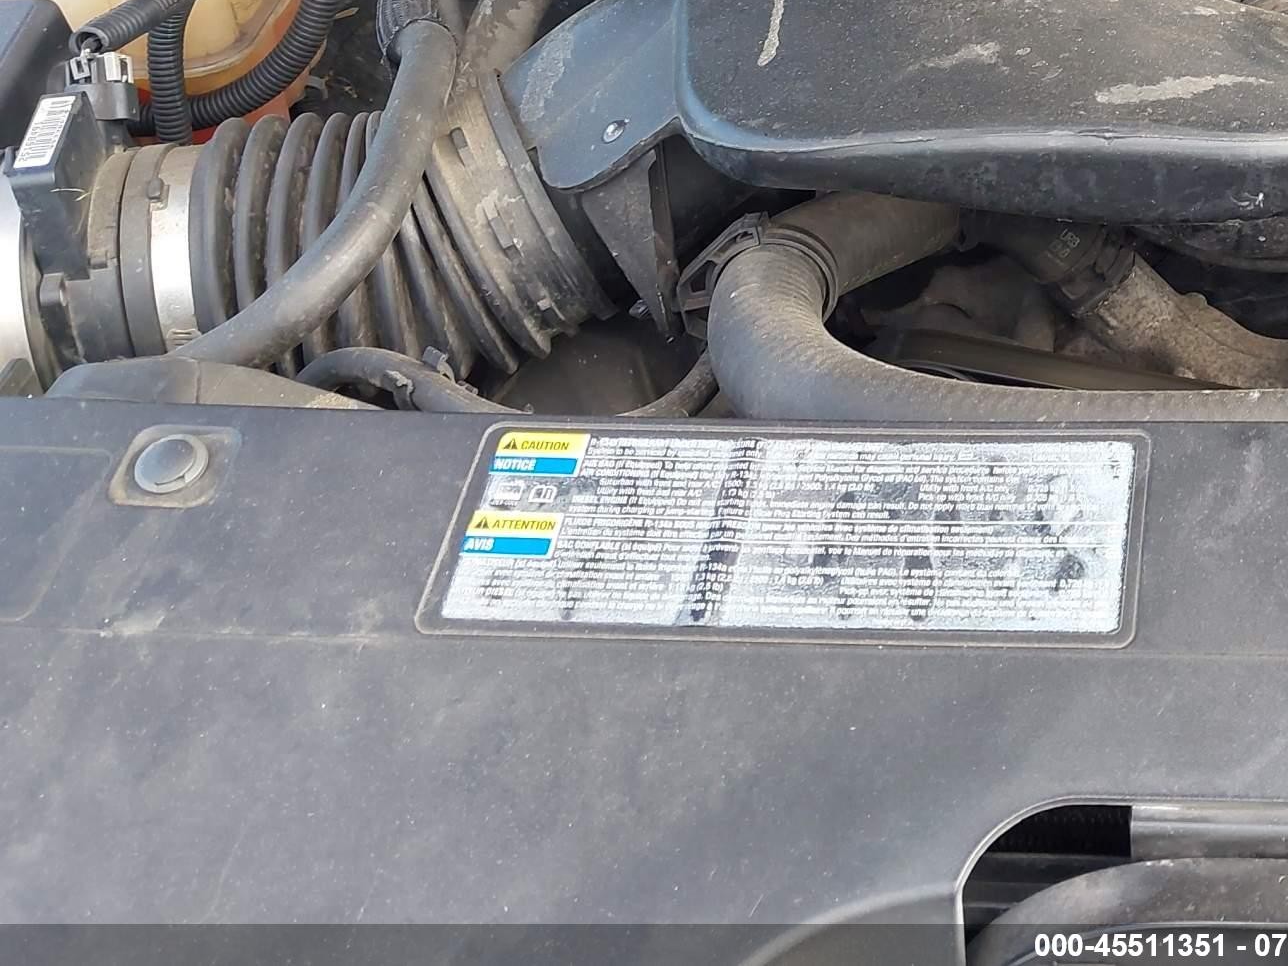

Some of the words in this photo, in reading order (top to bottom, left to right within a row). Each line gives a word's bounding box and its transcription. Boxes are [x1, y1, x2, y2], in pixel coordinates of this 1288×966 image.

[520, 441, 570, 451] CAUTION
[493, 457, 537, 471] NOTICE
[491, 520, 556, 530] ATTENTION
[463, 537, 495, 551] AVIS
